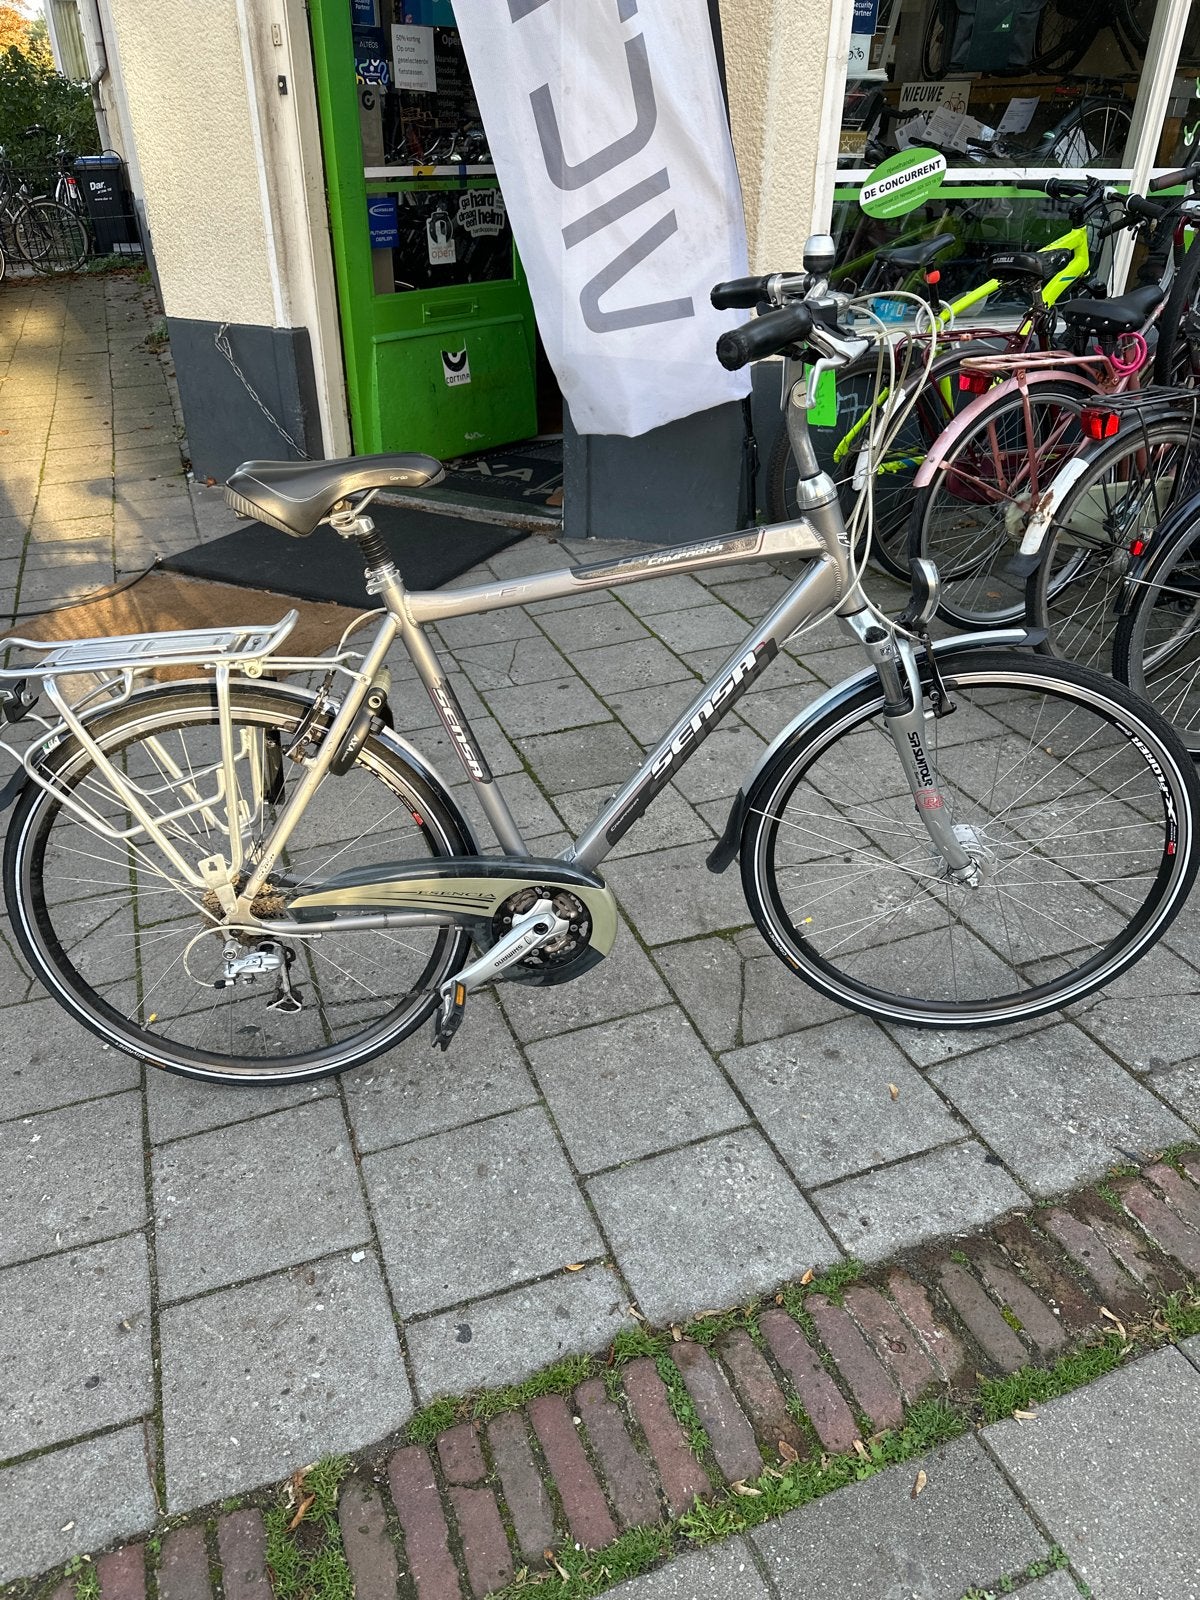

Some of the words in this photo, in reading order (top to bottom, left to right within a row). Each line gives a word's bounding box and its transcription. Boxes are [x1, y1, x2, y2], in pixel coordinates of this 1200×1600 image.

[854, 0, 874, 10] ecurity
[901, 86, 944, 102] NIEUWE
[862, 187, 878, 200] DE
[878, 159, 942, 193] CONCURRENT
[461, 198, 470, 210] ga
[470, 191, 494, 208] hard
[478, 208, 503, 226] helm
[431, 250, 454, 260] open
[346, 733, 360, 753] AXA
